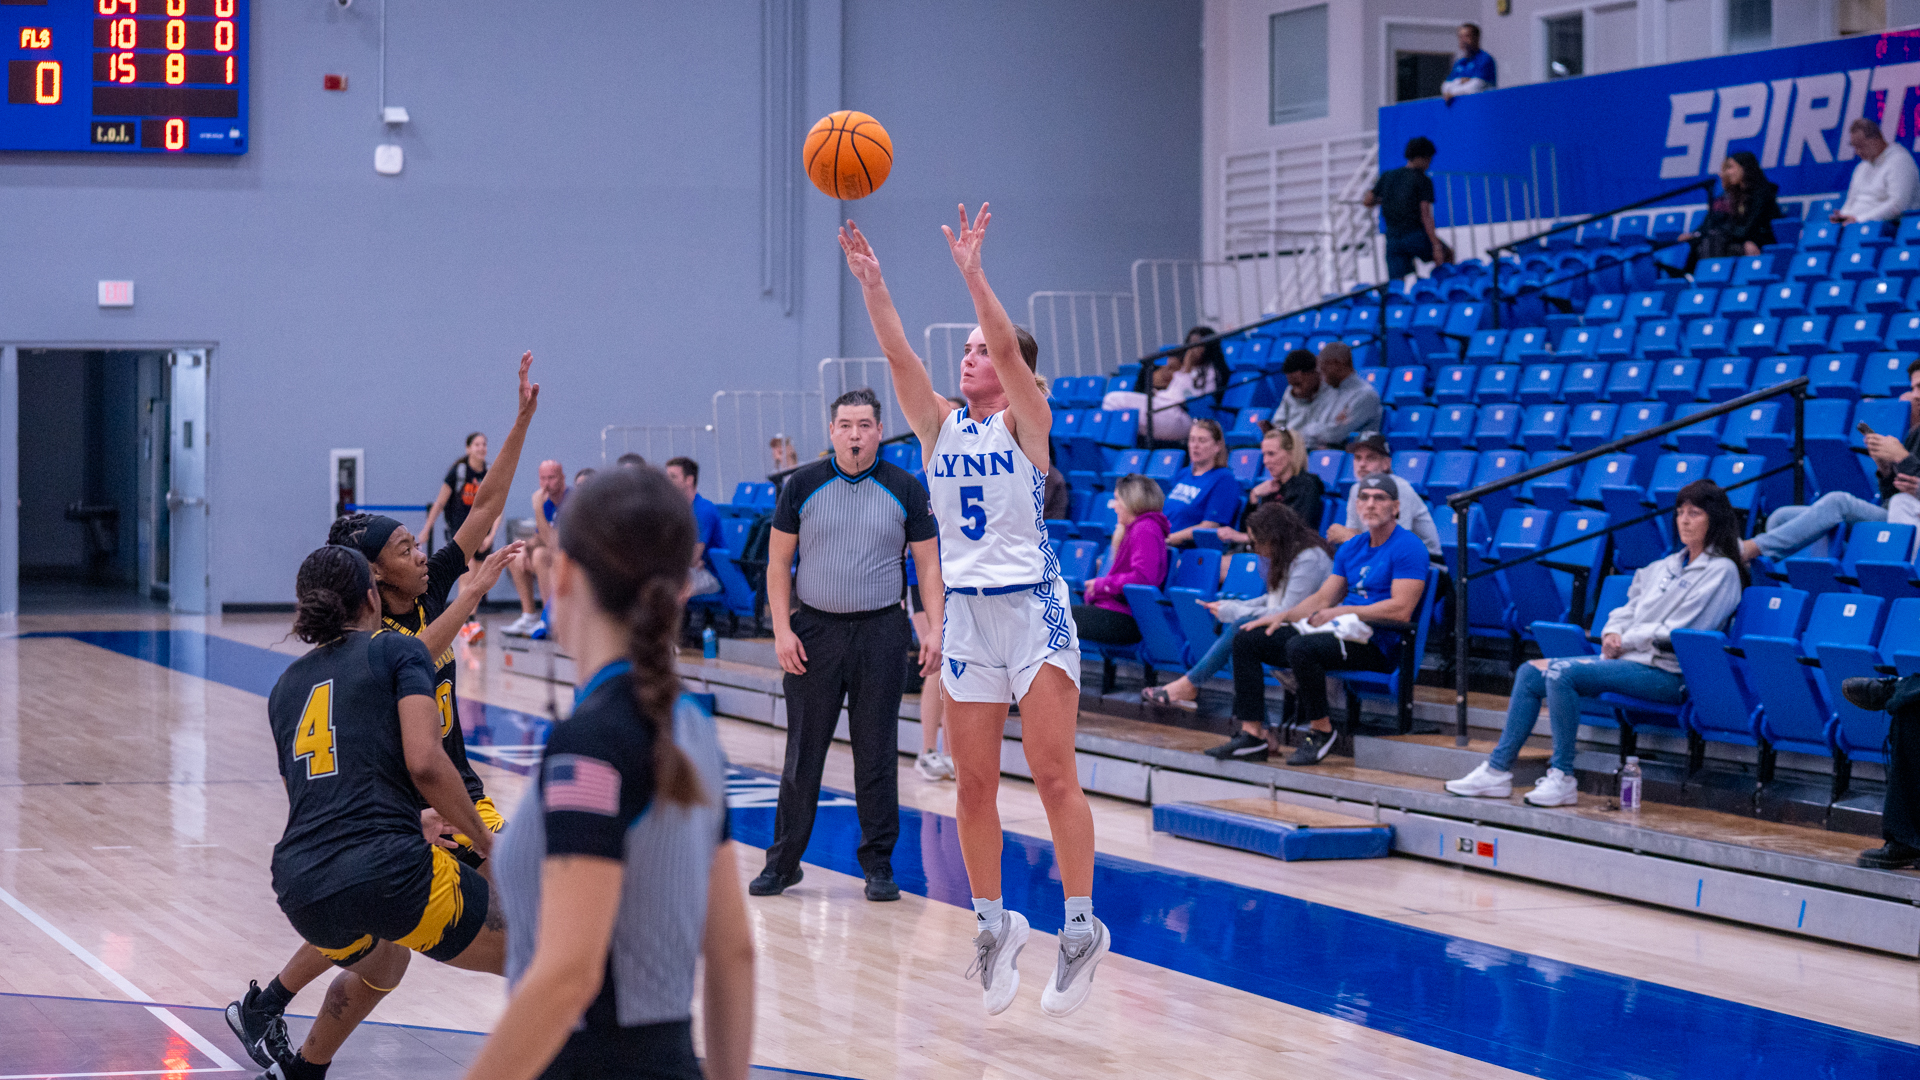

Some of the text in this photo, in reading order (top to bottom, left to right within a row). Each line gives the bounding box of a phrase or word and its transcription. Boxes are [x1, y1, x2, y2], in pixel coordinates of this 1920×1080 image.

[20, 28, 51, 49] FLS
[110, 18, 234, 52] 10 0 0
[35, 61, 61, 104] 0
[109, 52, 234, 85] 15 8 1
[165, 118, 185, 150] 0
[934, 450, 1015, 478] LYNN
[960, 485, 988, 541] 5
[293, 679, 339, 780] 4
